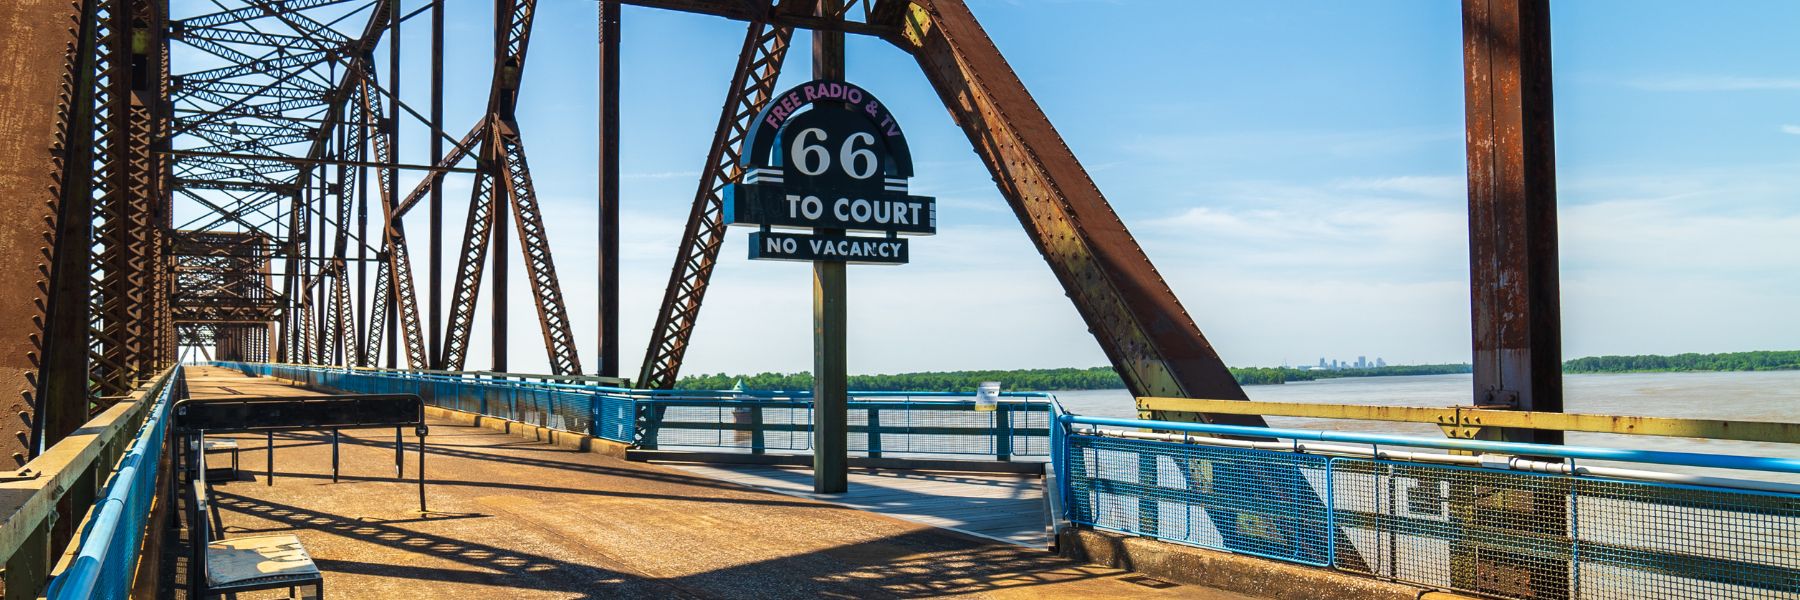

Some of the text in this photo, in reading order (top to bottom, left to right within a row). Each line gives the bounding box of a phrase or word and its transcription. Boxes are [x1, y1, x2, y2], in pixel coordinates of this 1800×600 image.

[765, 82, 902, 139] FREE RADIO & TV
[790, 127, 878, 180] 66
[785, 194, 922, 226] TO COURT
[766, 237, 902, 258] NO VACANCY
